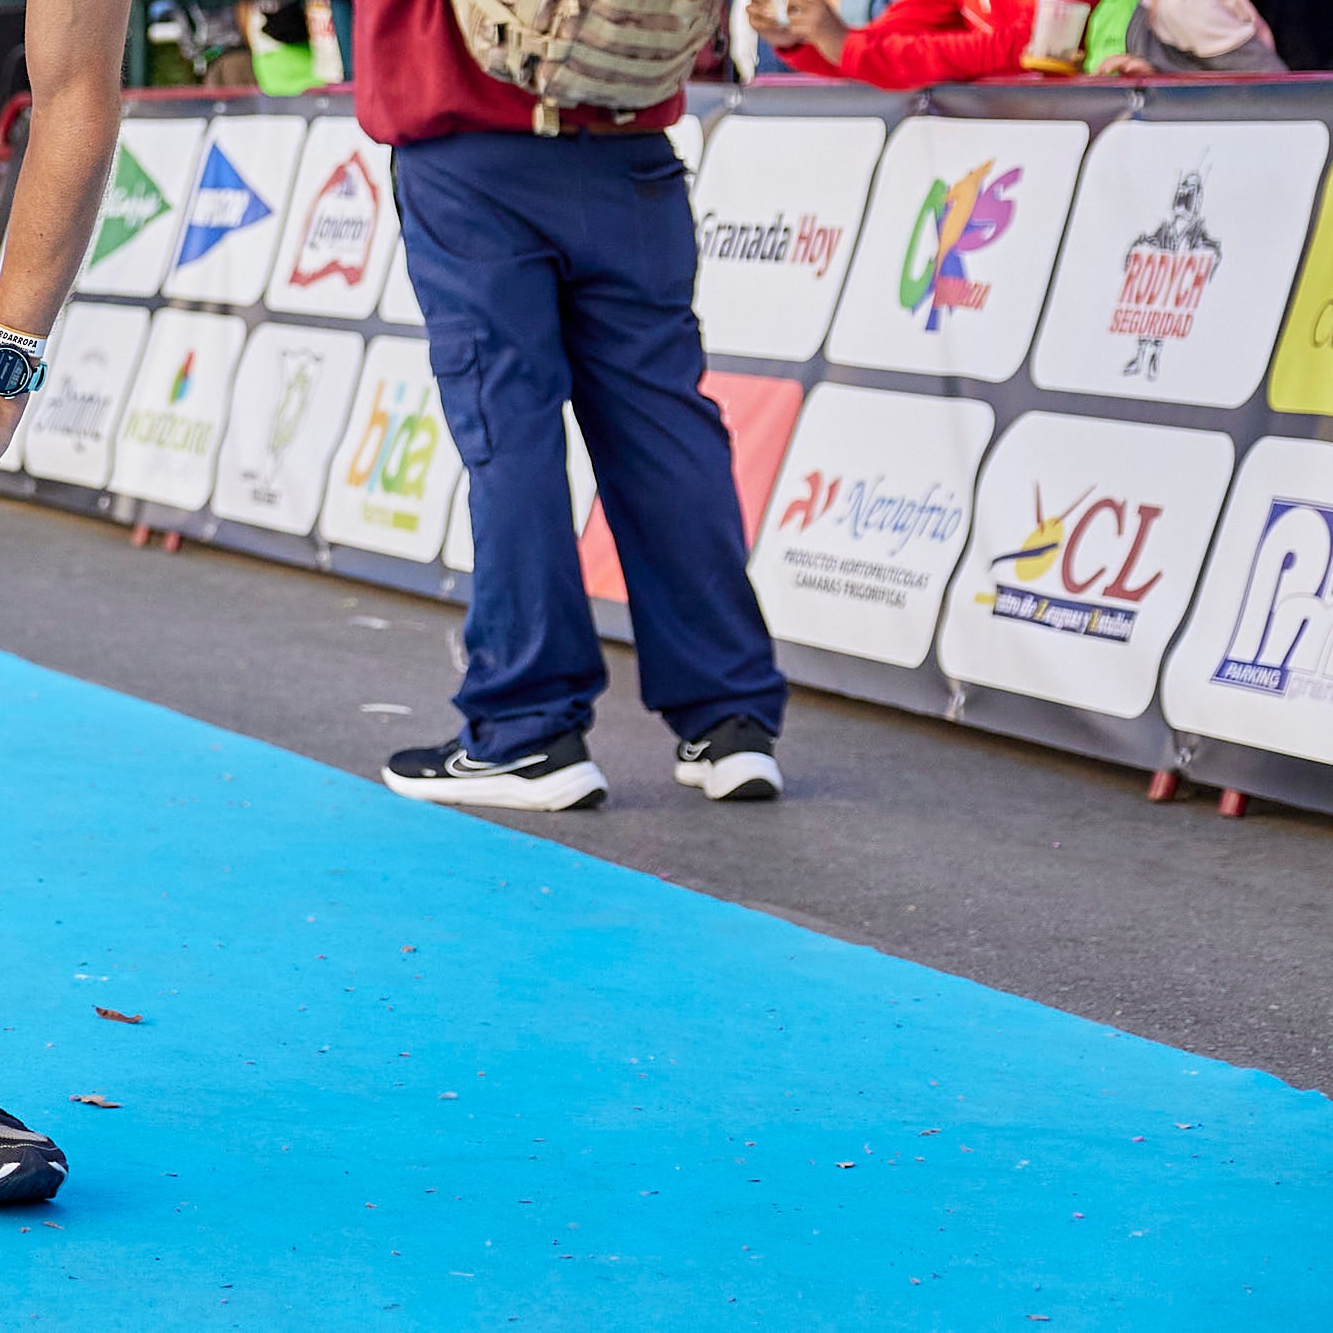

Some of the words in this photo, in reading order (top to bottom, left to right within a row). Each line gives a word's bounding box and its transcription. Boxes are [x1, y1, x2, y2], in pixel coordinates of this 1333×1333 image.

[700, 210, 791, 263] Granada
[791, 212, 844, 280] Hoy
[1118, 251, 1214, 309] RODYCH
[1109, 307, 1195, 338] SEGURIDAD
[346, 377, 438, 500] bida
[837, 474, 964, 557] Nevafrio
[783, 546, 838, 571] PRODUCTOS
[1060, 495, 1164, 603] CL
[1223, 661, 1284, 689] PARKING
